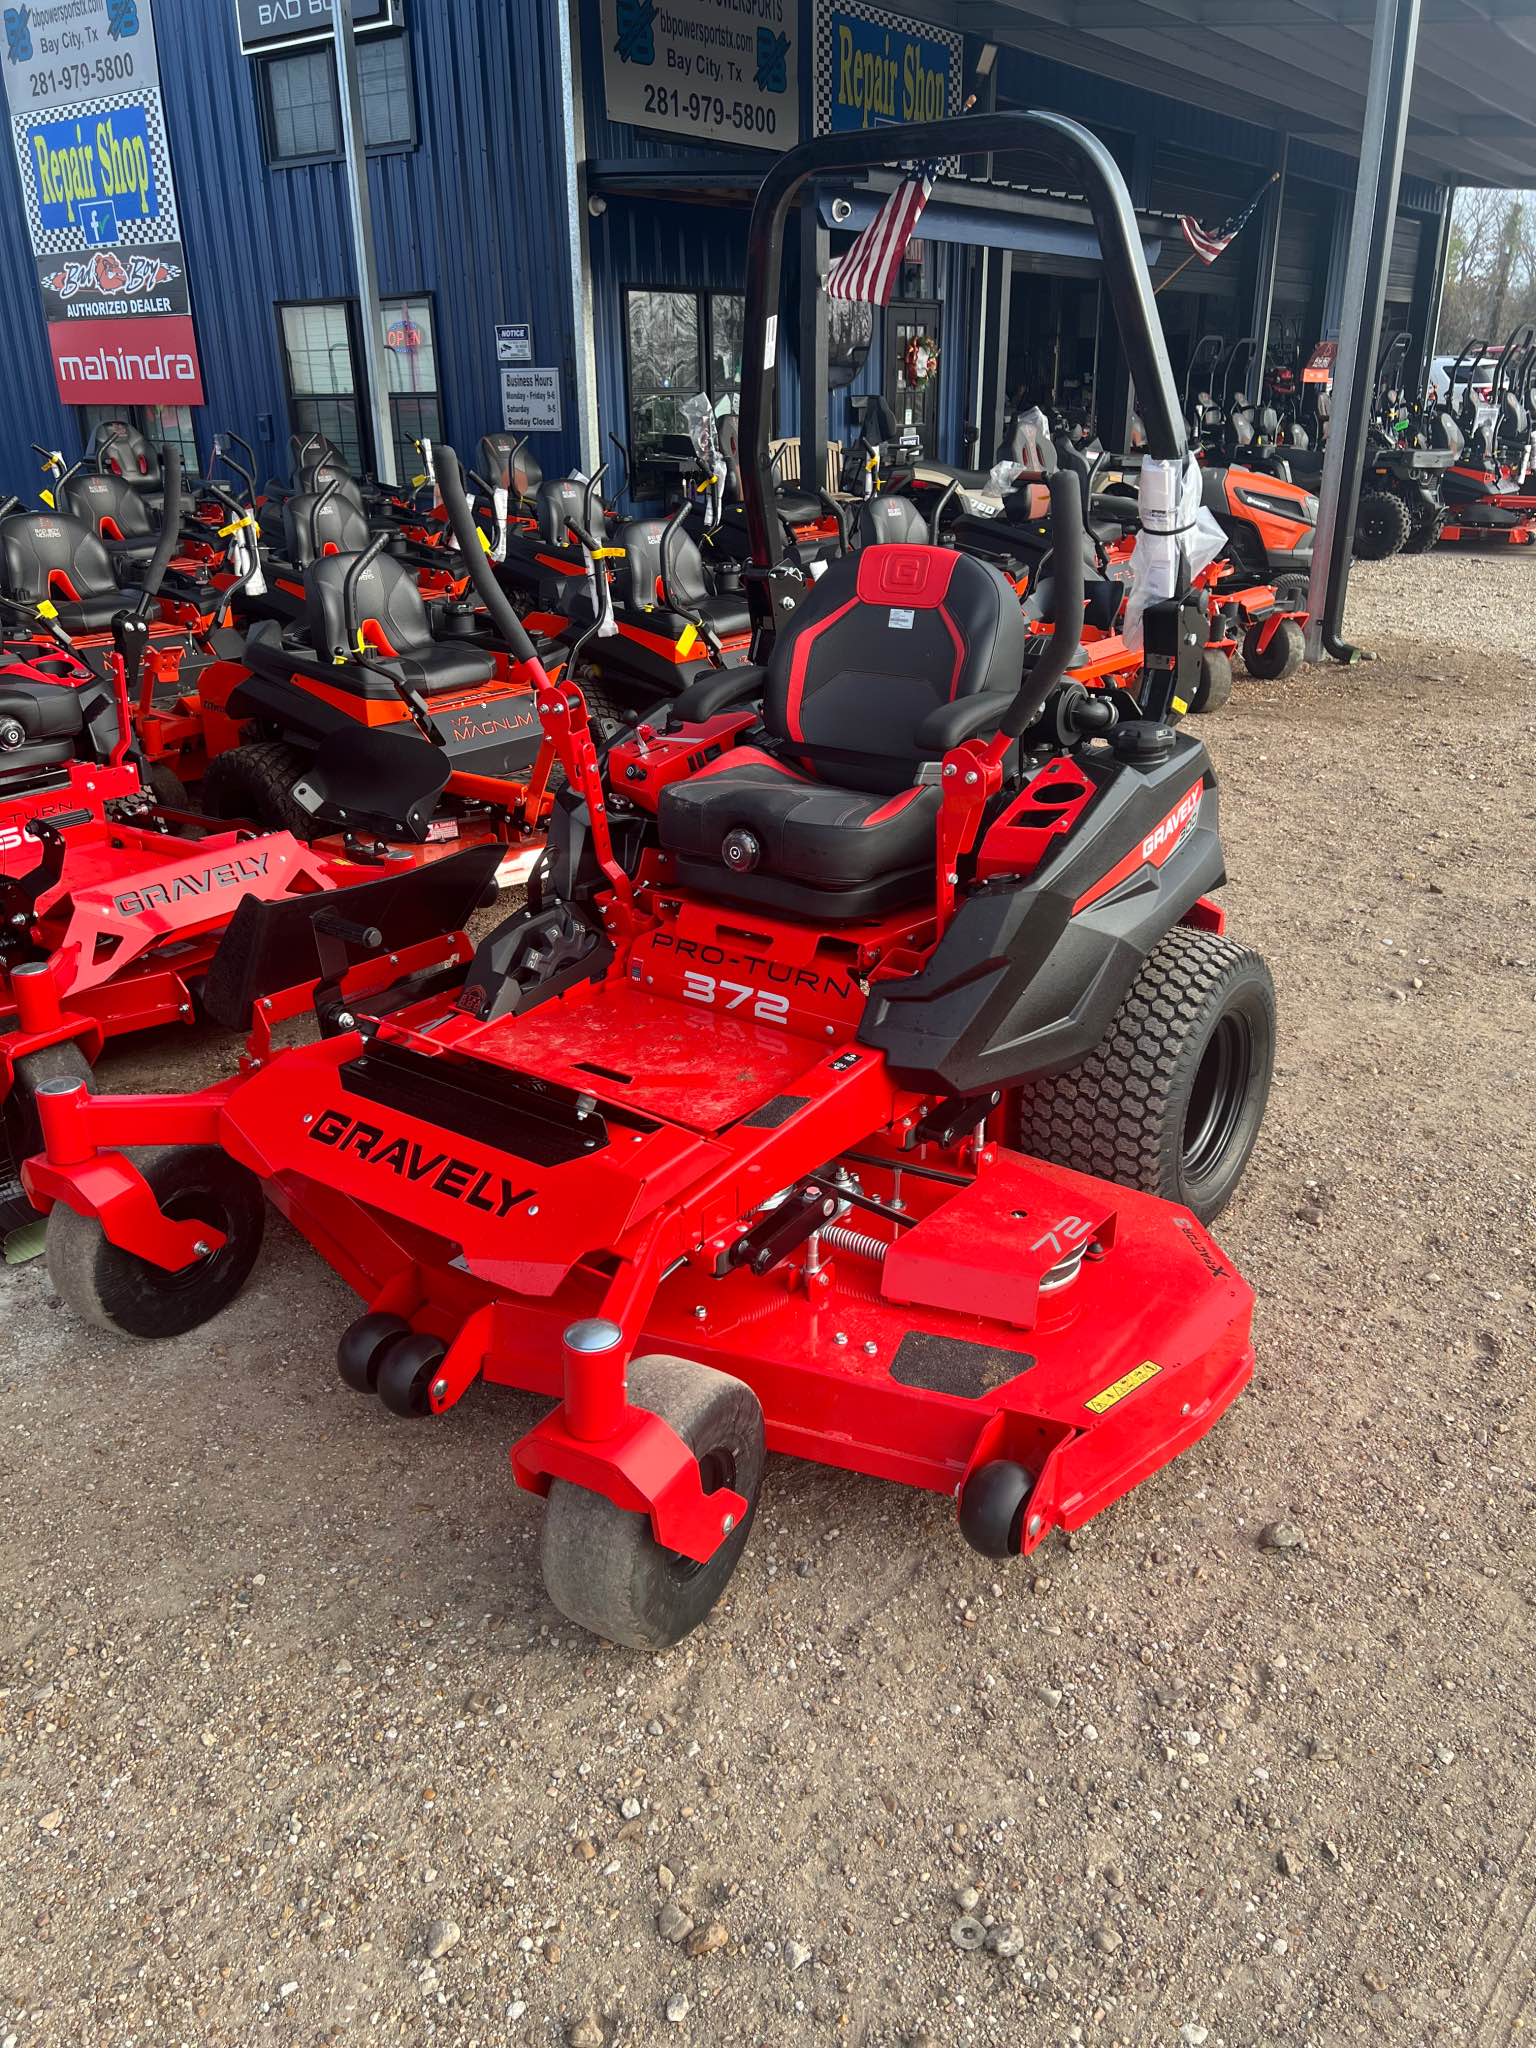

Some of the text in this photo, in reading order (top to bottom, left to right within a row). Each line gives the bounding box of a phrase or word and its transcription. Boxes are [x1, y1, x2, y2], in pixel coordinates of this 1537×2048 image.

[40, 26, 99, 54] Bay City, Tx
[660, 12, 753, 53] bbpowersportstx.com
[29, 52, 134, 97] 281-979-5800
[667, 49, 692, 76] Bay
[696, 55, 724, 82] City,
[727, 62, 743, 83] Tx
[838, 25, 898, 128] Repair
[644, 84, 776, 134] 281-979-5800
[33, 117, 149, 223] Repair Shop
[60, 256, 160, 299] Bad Boy
[67, 297, 172, 318] AUTHORIZED DEALER
[387, 329, 422, 347] OPEN
[501, 329, 525, 337] NOTICE
[58, 346, 195, 381] mahindra
[506, 374, 553, 387] Business Hours
[506, 391, 525, 402] Monday
[530, 390, 546, 401] Friday
[506, 405, 530, 415] Saturday
[508, 416, 554, 427] Sunday Closed
[453, 712, 533, 742] MAGNUM
[1142, 786, 1199, 860] GRAVELY
[113, 852, 269, 917] GRAVELY
[651, 932, 851, 999] PRO-TURN
[682, 970, 790, 1025] 372
[308, 1108, 538, 1218] GRAVELY
[1030, 1215, 1092, 1254] 72
